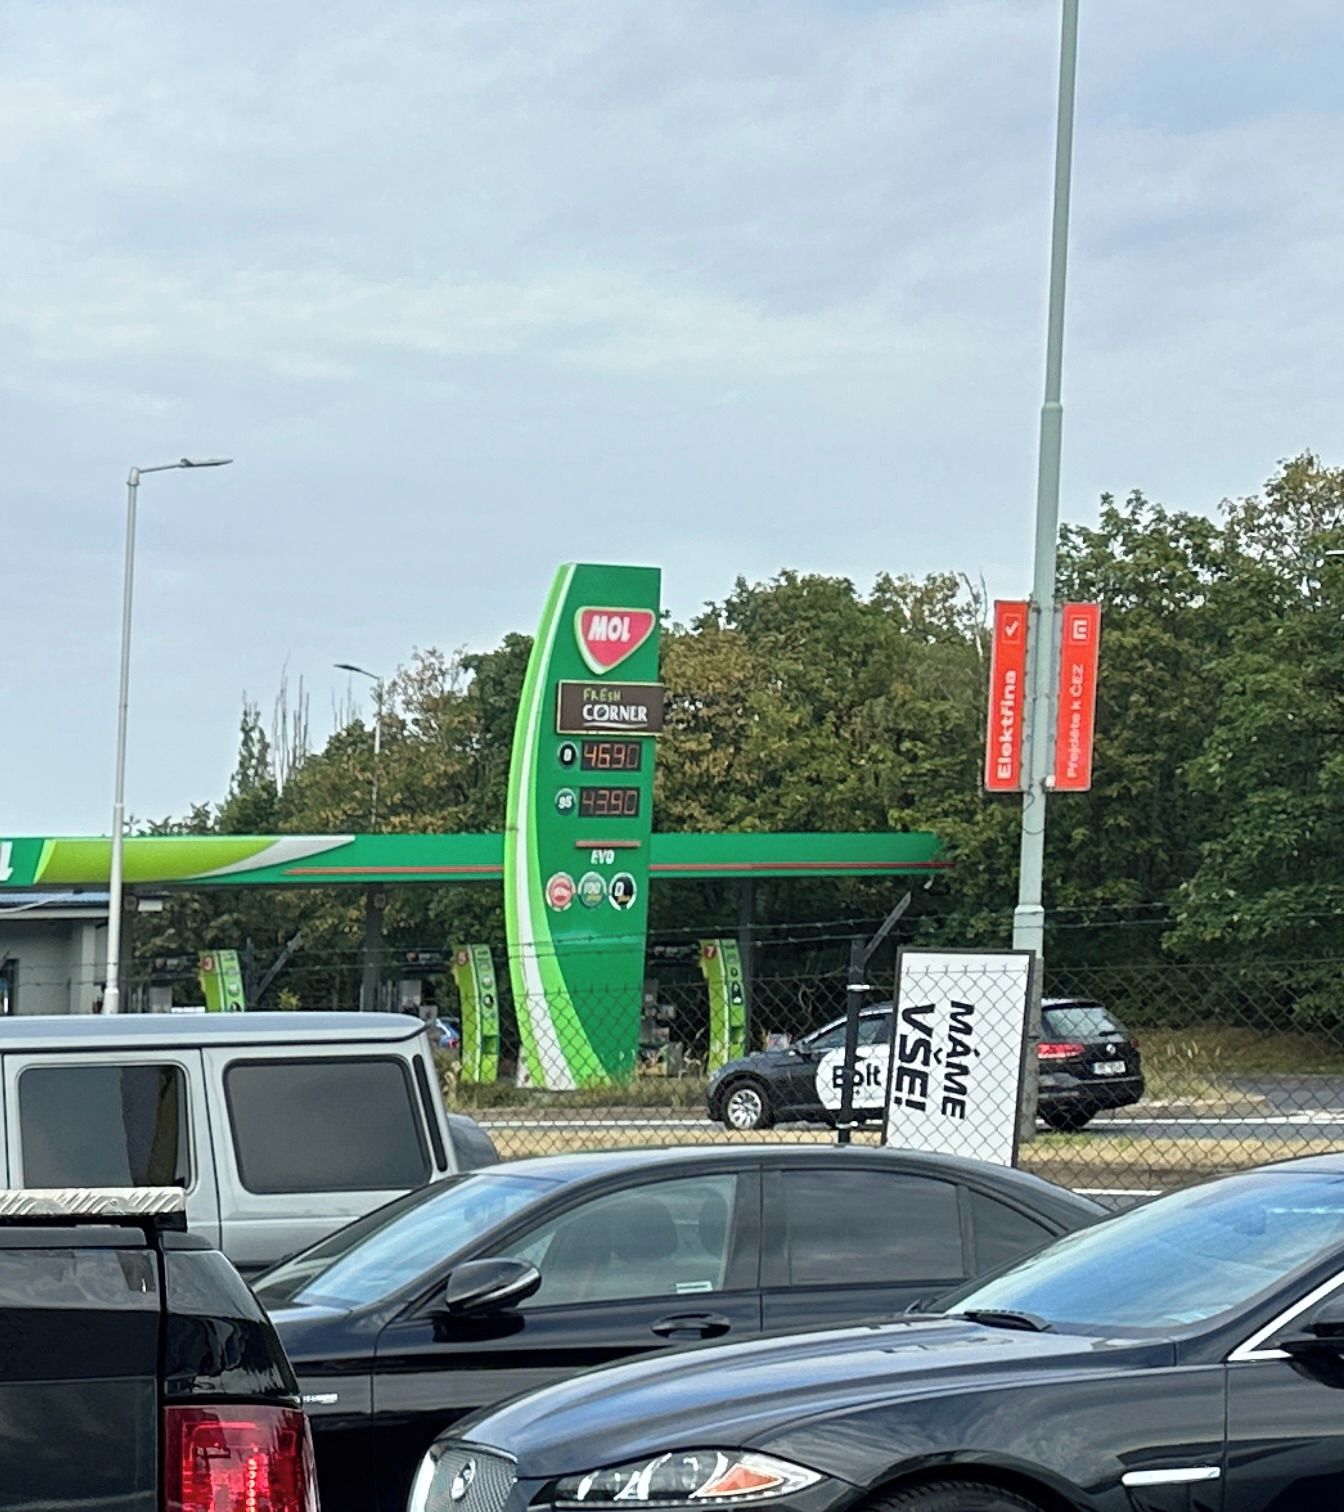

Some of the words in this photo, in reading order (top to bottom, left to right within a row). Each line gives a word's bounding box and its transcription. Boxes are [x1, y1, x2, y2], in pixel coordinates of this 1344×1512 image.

[587, 615, 631, 642] MOL
[1069, 664, 1084, 698] ČEZ
[582, 704, 648, 722] CORNER
[1071, 700, 1081, 710] k
[997, 670, 1016, 779] Elektřina
[558, 795, 572, 809] 95
[591, 850, 615, 865] EVO
[893, 1003, 943, 1112] VŠE!
[941, 1000, 981, 1120] MÁME
[832, 1063, 882, 1089] Bolt
